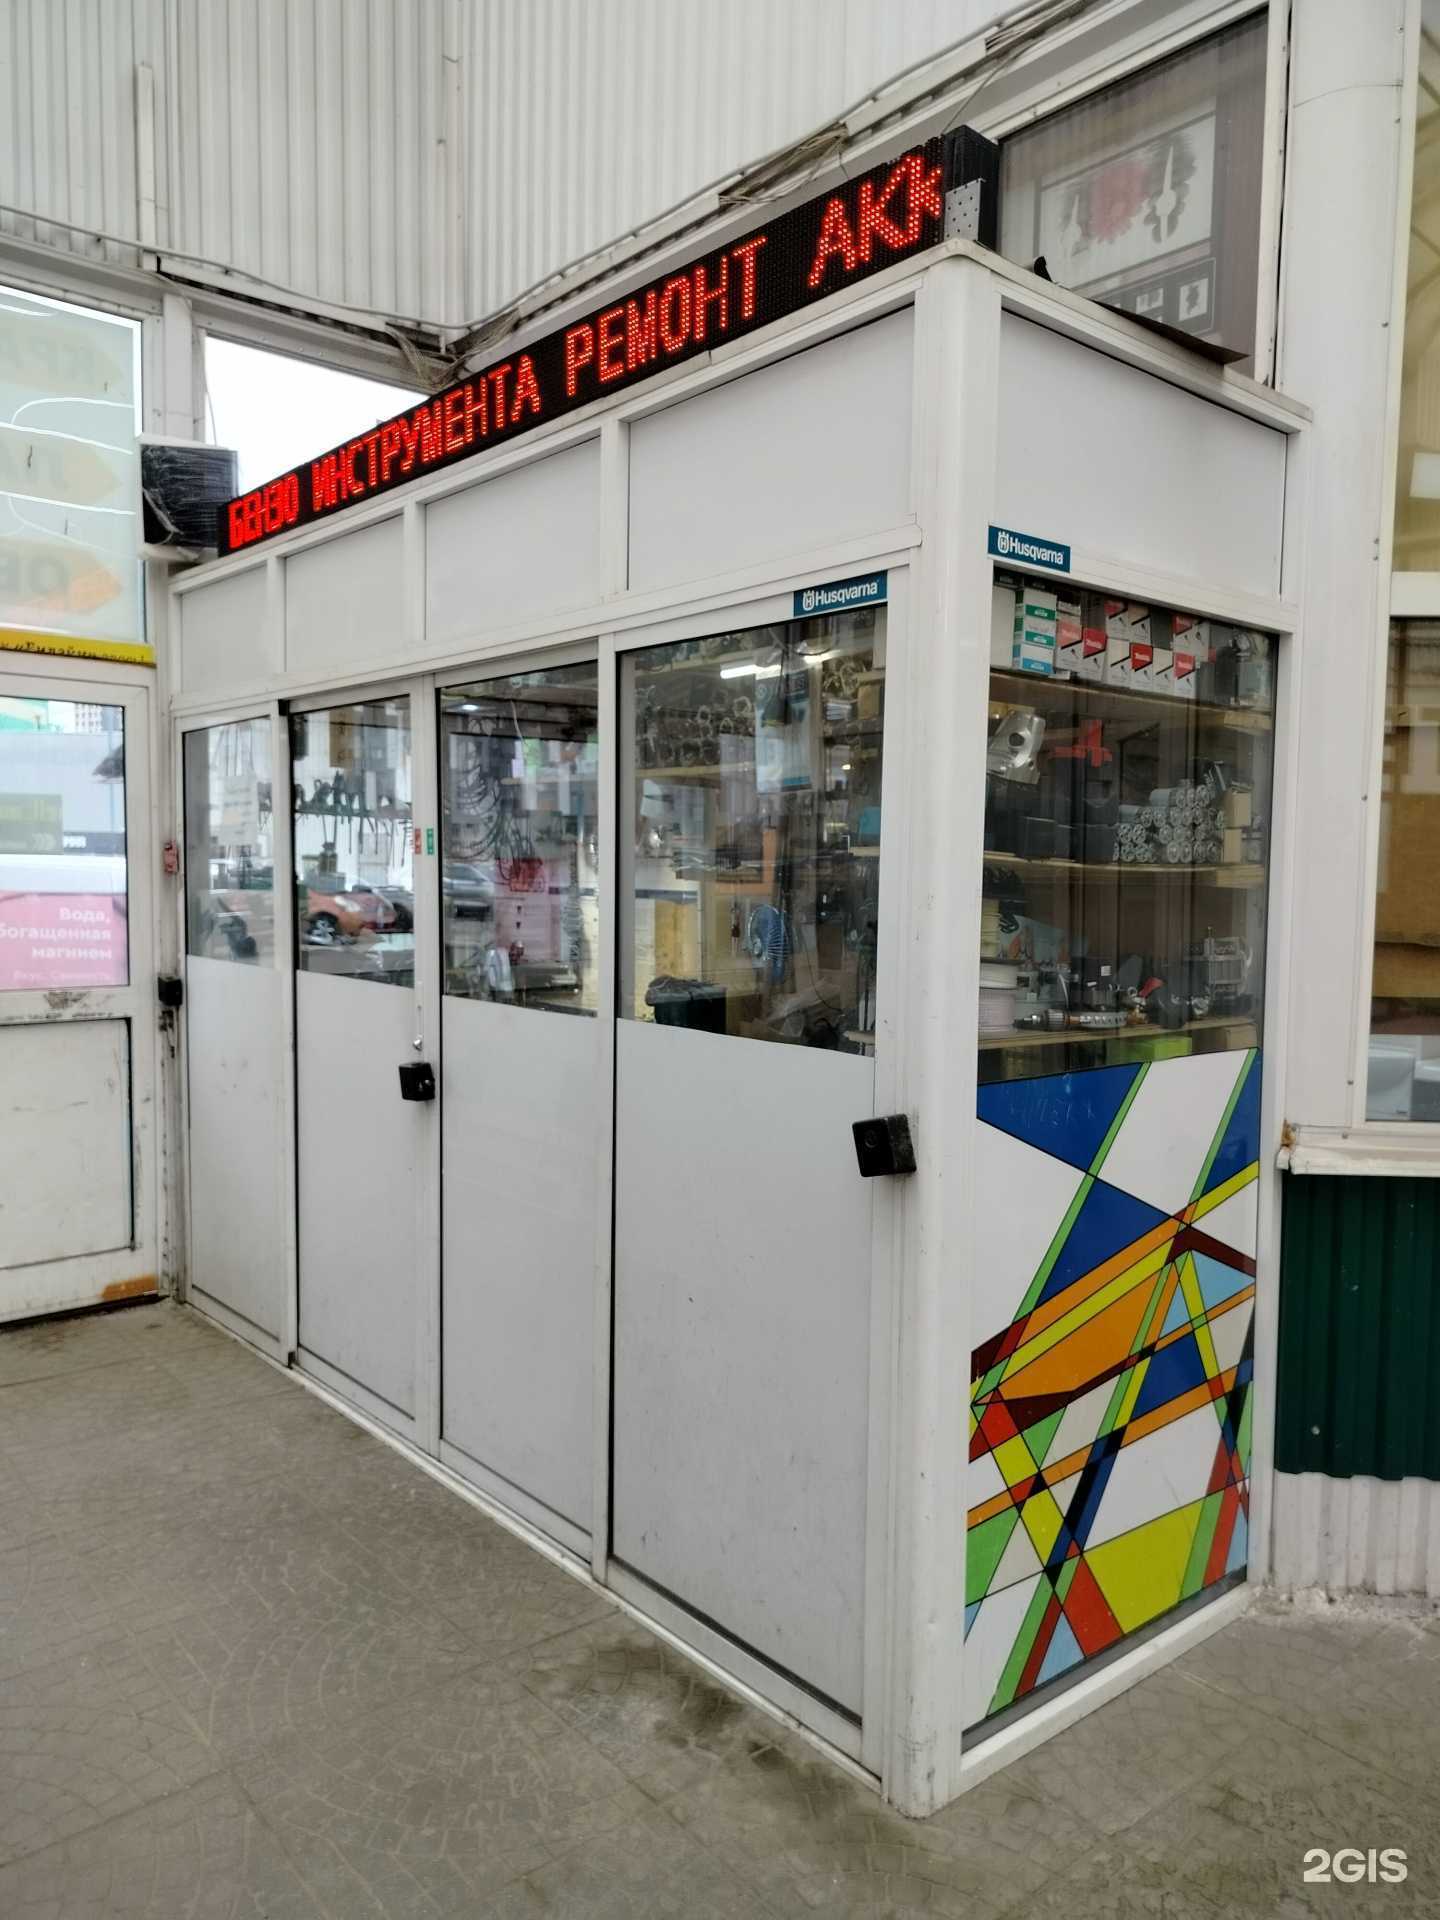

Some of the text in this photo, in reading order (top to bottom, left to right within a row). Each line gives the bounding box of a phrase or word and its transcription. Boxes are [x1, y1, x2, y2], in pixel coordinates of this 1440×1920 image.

[311, 354, 541, 512] ИНСТРУМЕНТА
[565, 236, 767, 397] РЕМОНТ
[1009, 536, 1064, 565] Husqvarna
[815, 581, 878, 607] Husqvarna
[59, 907, 111, 924] Вода,
